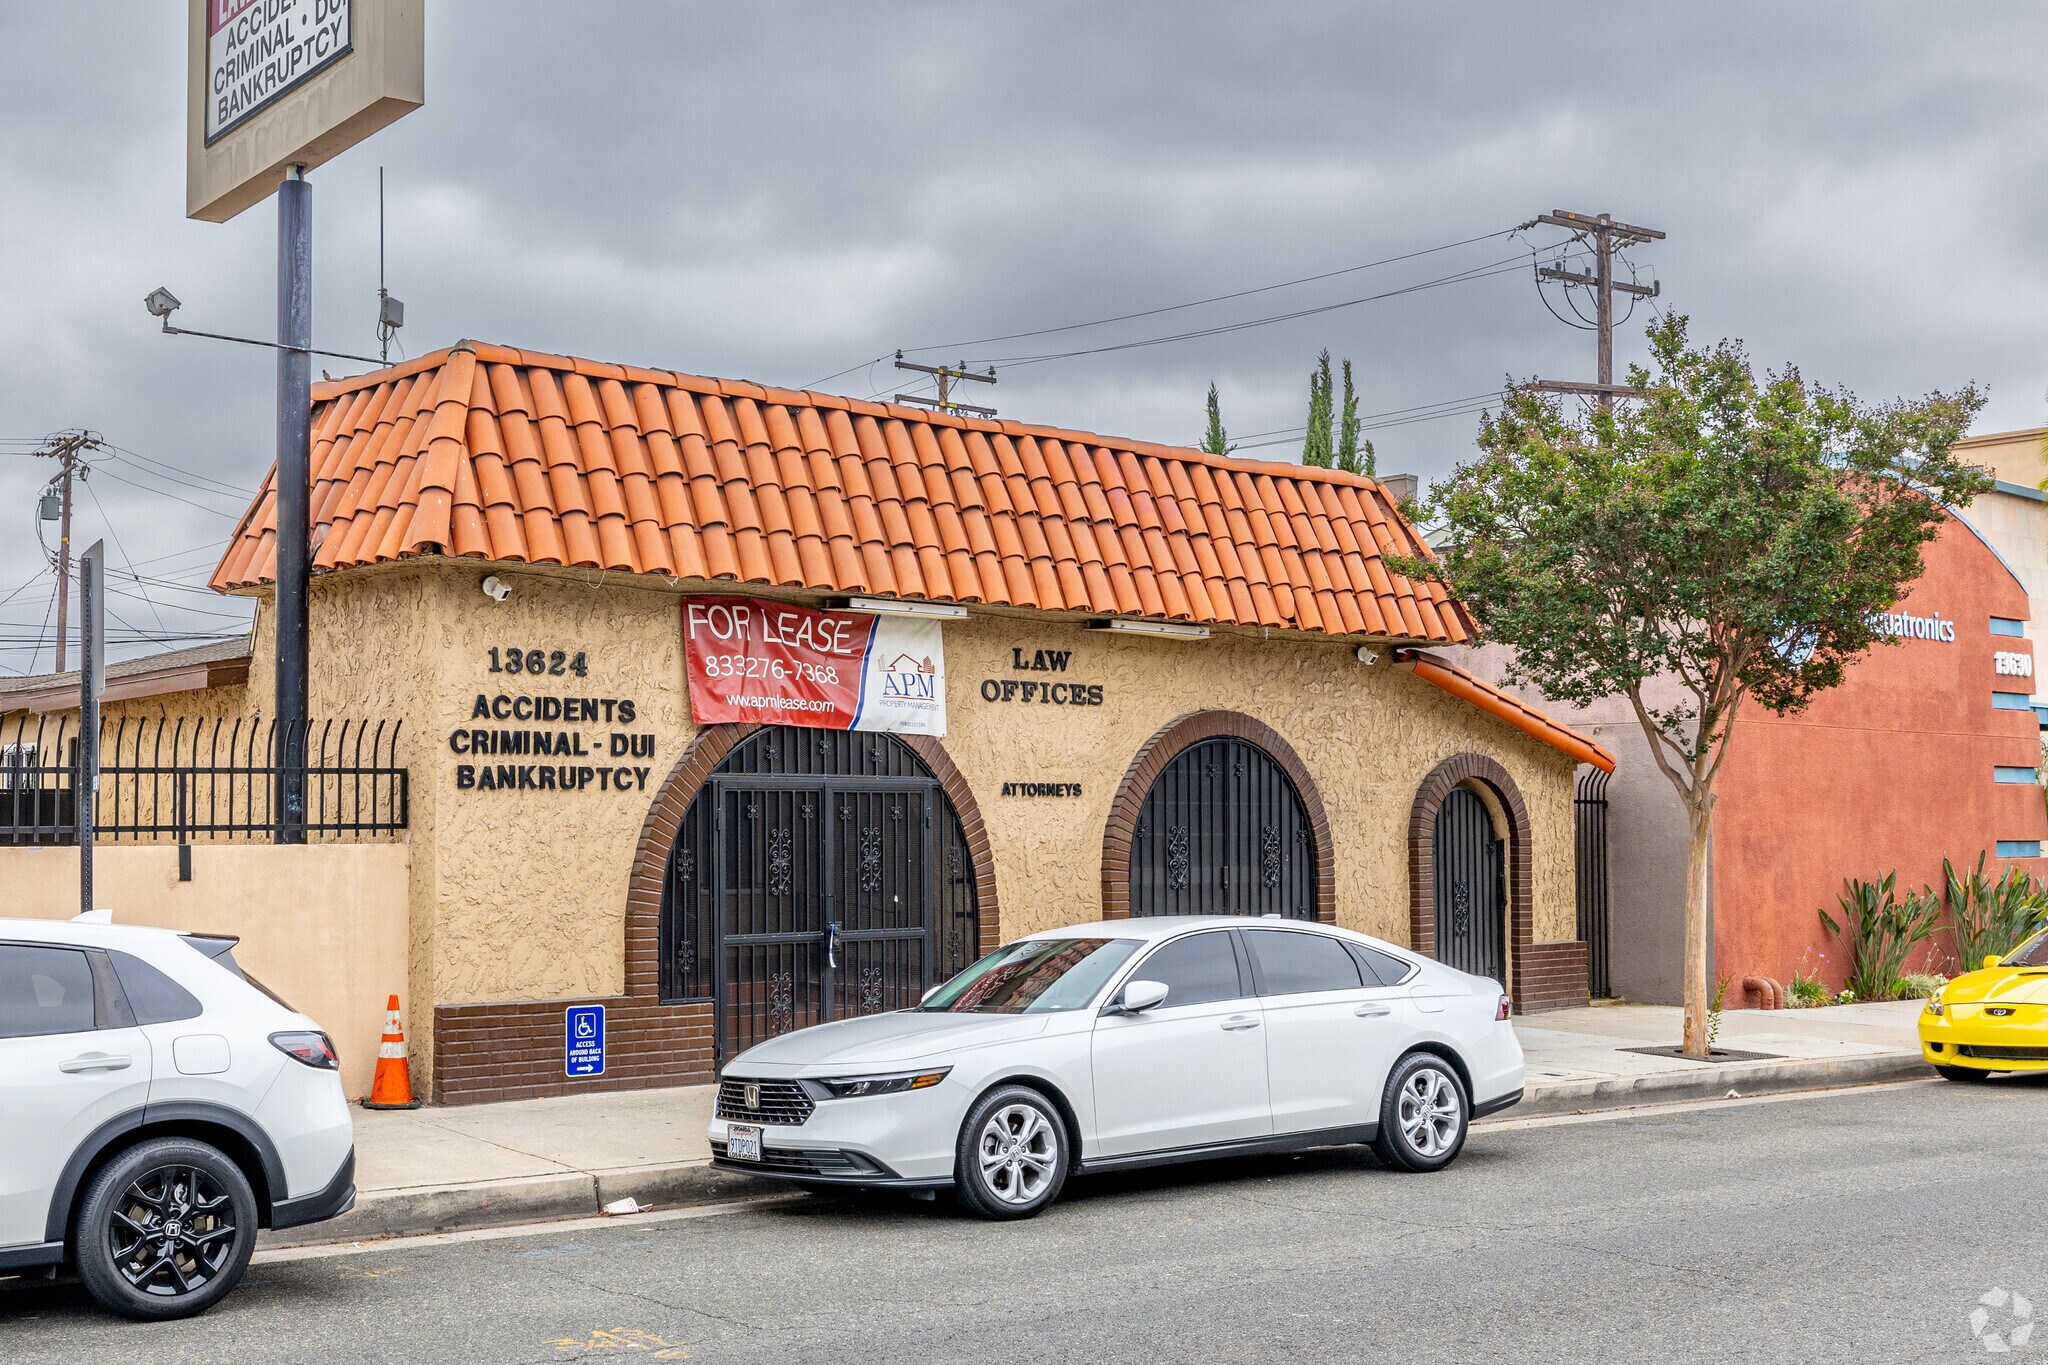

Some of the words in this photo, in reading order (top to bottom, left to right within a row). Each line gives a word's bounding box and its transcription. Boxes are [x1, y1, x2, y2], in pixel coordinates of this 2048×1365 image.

[226, 0, 297, 56] ACCIDE
[214, 18, 294, 95] CRIMINAL
[315, 0, 346, 26] DU
[218, 15, 342, 125] BANKRUPTCY
[687, 603, 751, 641] FOR
[761, 608, 853, 654] LEASE
[488, 646, 588, 677] 13624
[1012, 647, 1072, 672] LAW
[1993, 651, 2032, 677] 13630
[882, 672, 935, 699] APM
[981, 679, 1103, 706] OFFICES
[471, 694, 637, 723] ACCIDENTS
[879, 699, 907, 709] PROPERTY
[450, 728, 589, 756] CRIMINAL
[610, 732, 655, 758] DUI
[457, 764, 650, 791] BANKRUPTCY
[1001, 781, 1082, 797] ATTORNEYS
[578, 1055, 600, 1063] BUILDING
